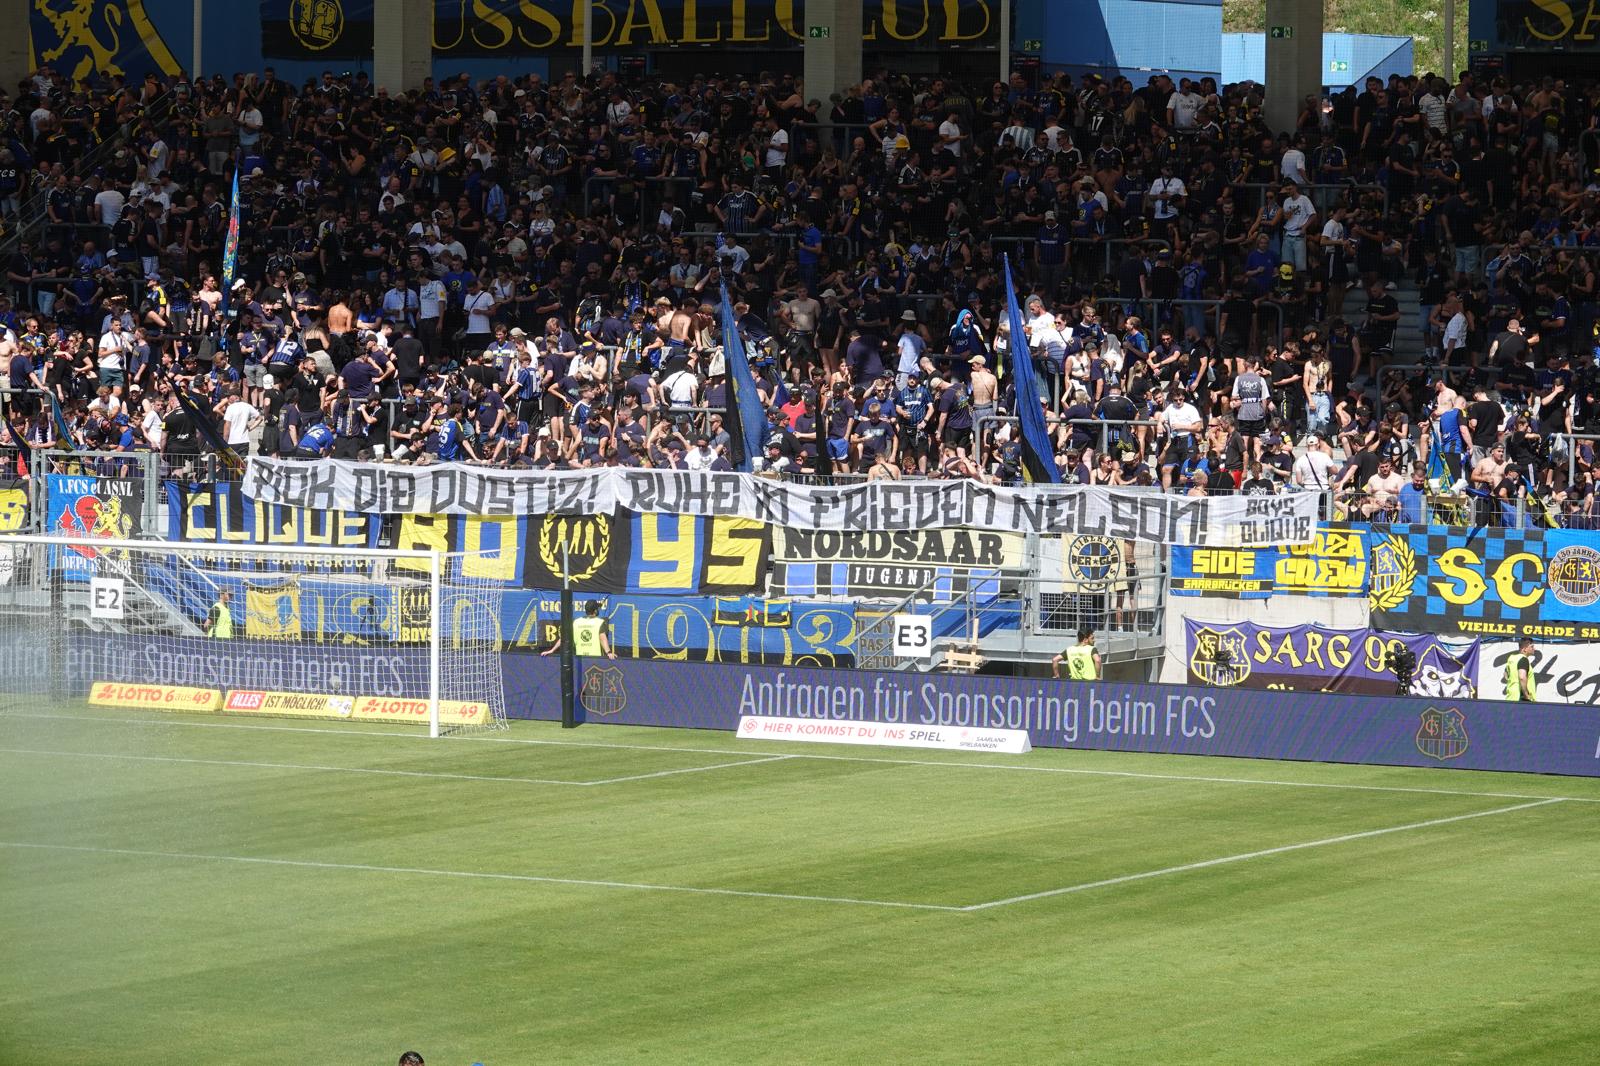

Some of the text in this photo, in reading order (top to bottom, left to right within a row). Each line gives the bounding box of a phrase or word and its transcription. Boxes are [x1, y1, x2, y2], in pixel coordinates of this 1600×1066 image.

[276, 339, 298, 356] 12
[104, 478, 133, 497] ASNL
[626, 472, 740, 513] RUHE
[809, 481, 997, 530] FRIEDEN
[1012, 491, 1209, 545] NELSON!
[1245, 498, 1295, 517] BOYS
[186, 493, 367, 545] CLIQUE
[1240, 516, 1310, 543] CLIQUE
[784, 527, 1005, 566] NORDSAAR
[1192, 550, 1255, 575] SIDE
[853, 567, 932, 586] JUGEND
[1183, 579, 1261, 591] SAARBRÜCKEN
[95, 588, 120, 610] E2
[898, 624, 928, 648] E3
[1458, 621, 1517, 635] VIEILLE
[1523, 624, 1575, 638] GARDE
[1253, 630, 1352, 670] SARG
[359, 654, 404, 697] FCS
[117, 685, 162, 701] LOTTO
[231, 692, 262, 708] ALLES
[264, 694, 281, 708] IST
[282, 694, 327, 711] MÖGLICH!
[381, 701, 427, 715] LOTTO
[739, 673, 1216, 743] Anfragen für Sponsoring beim FCS
[763, 722, 946, 742] HIER KOMMST DU INS SPIEL.
